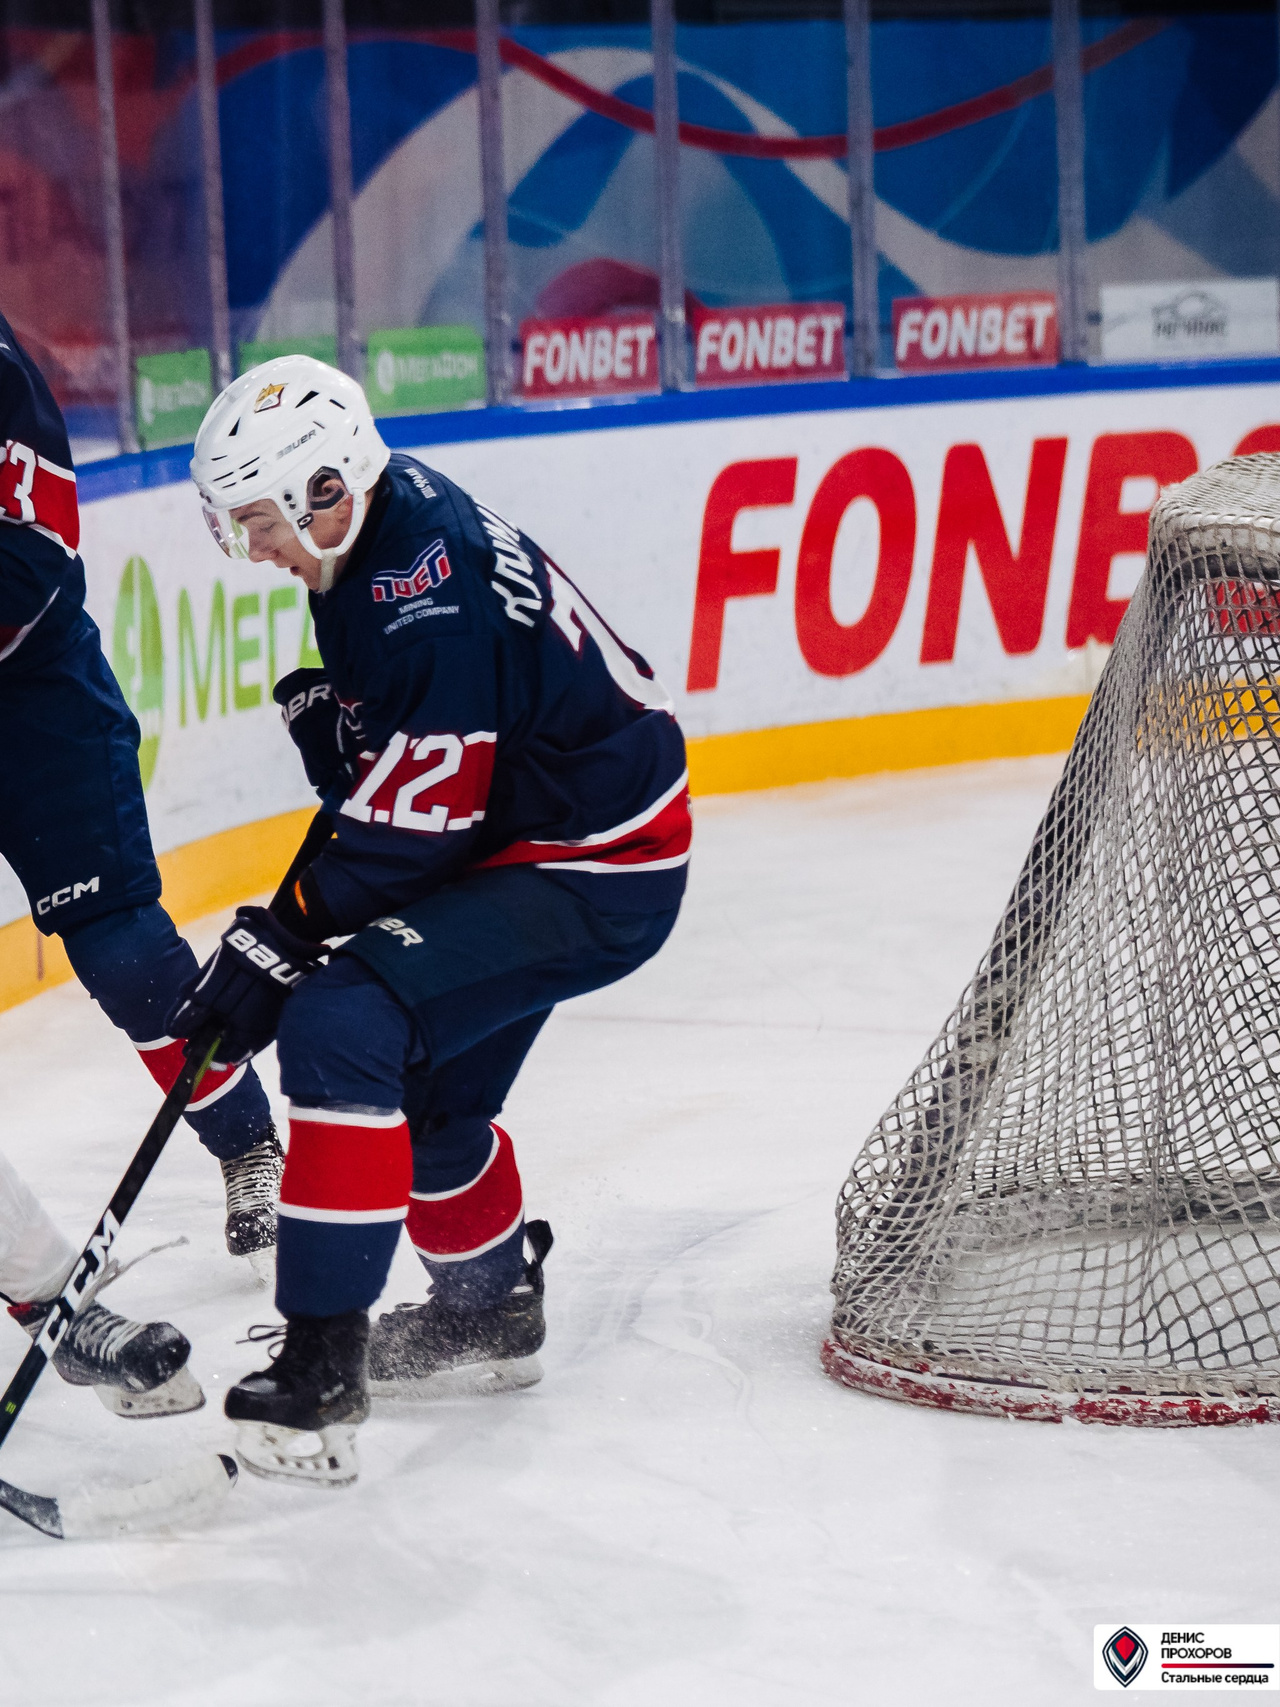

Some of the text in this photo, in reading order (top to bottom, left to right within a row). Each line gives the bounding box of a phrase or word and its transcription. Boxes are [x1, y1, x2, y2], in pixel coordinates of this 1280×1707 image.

[524, 325, 656, 387] FONBET
[696, 315, 843, 374] FONBET
[895, 302, 1054, 361] FONBET
[275, 429, 317, 461] BAUER
[383, 613, 415, 635] UNITED
[36, 875, 100, 916] CCM
[34, 1207, 121, 1361] CCM
